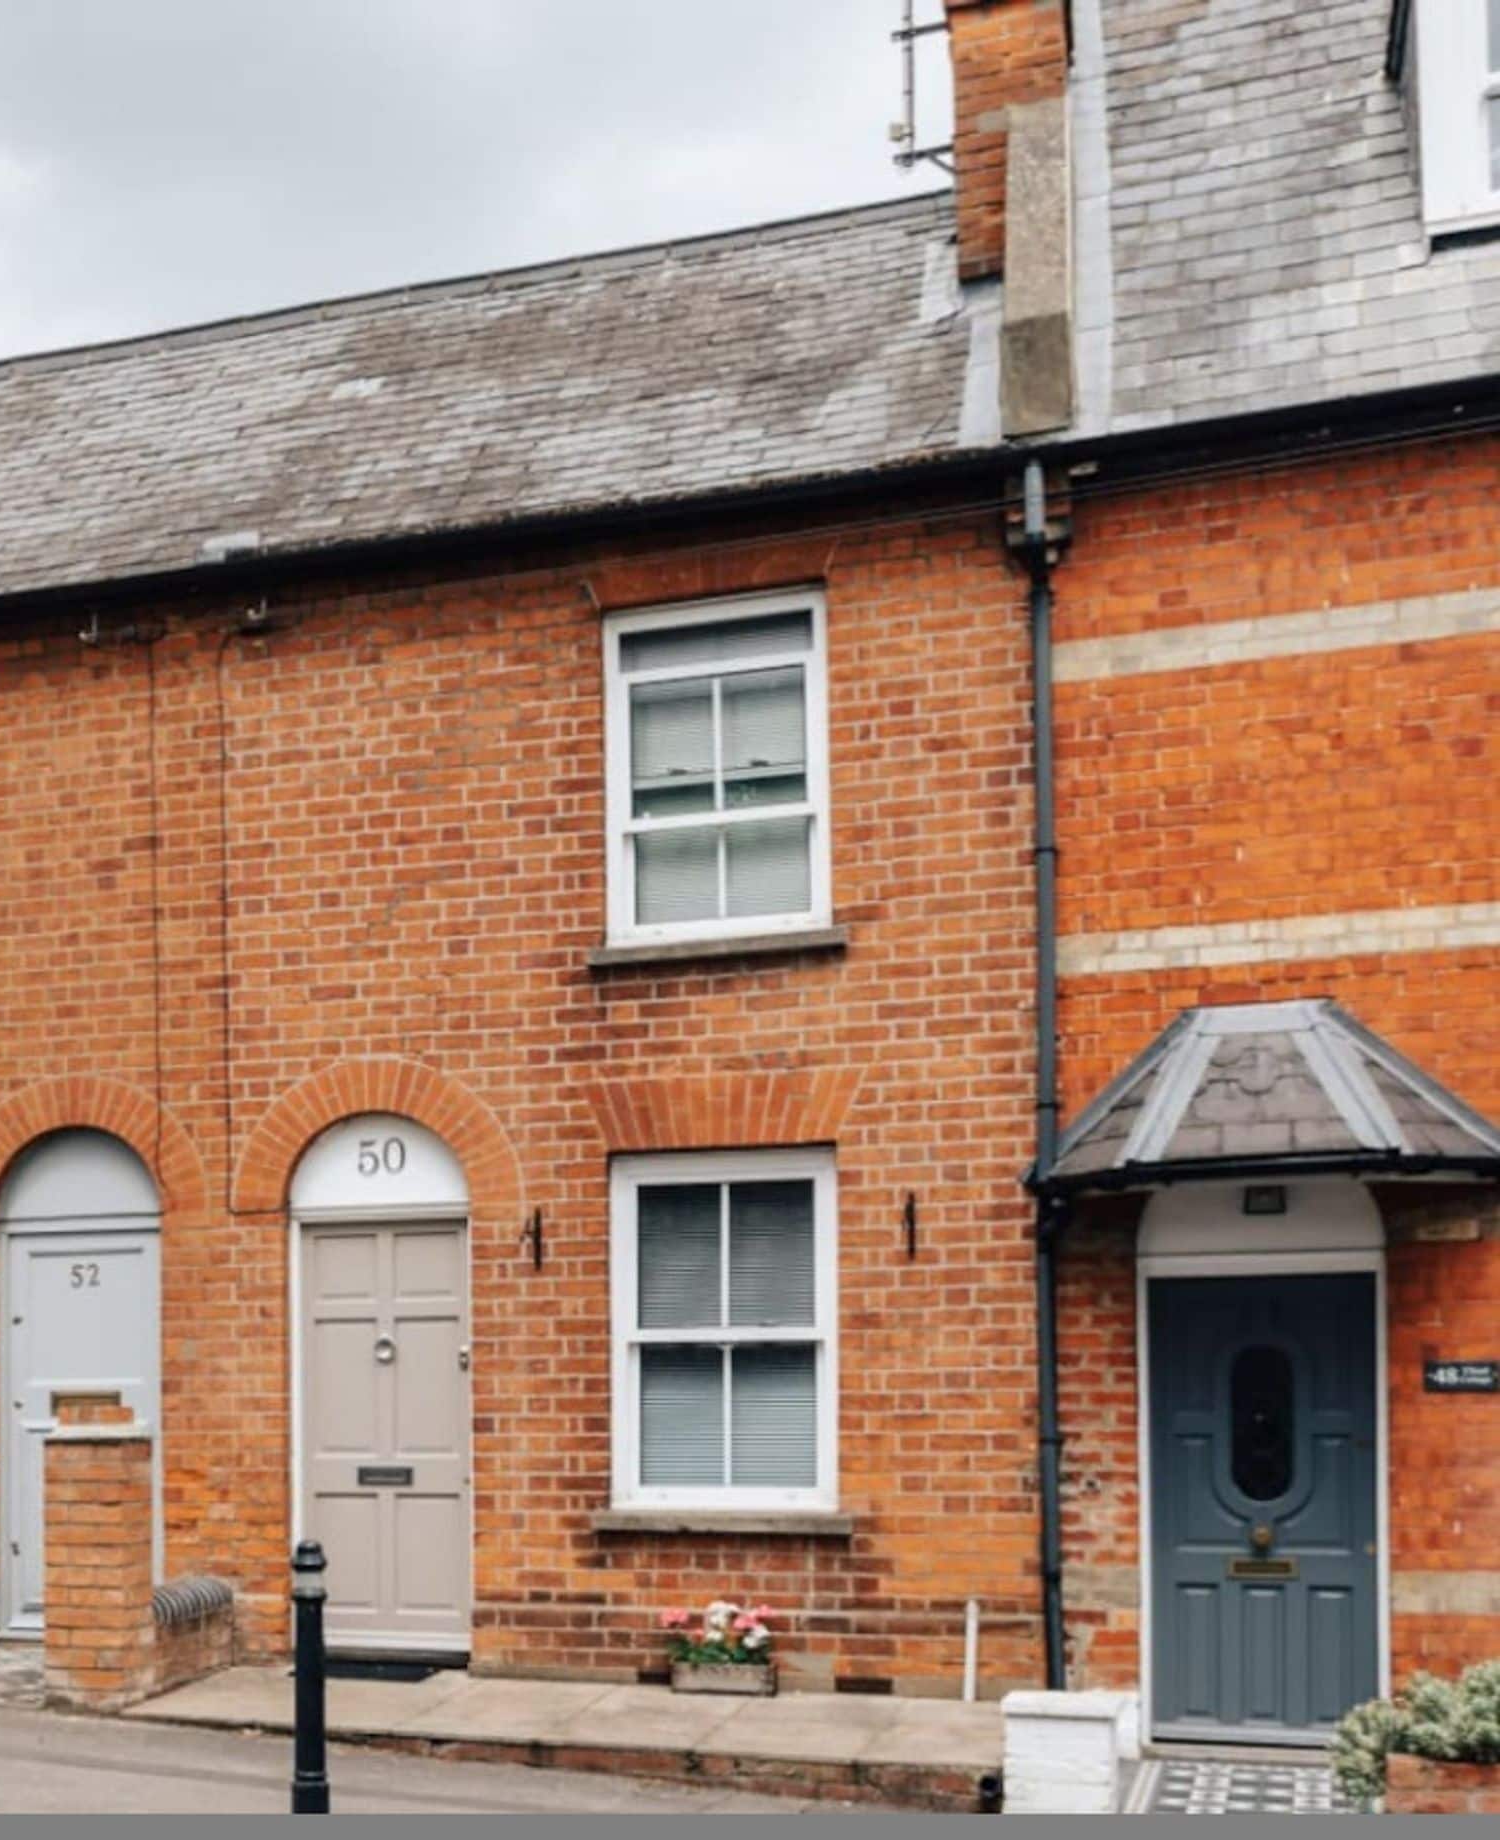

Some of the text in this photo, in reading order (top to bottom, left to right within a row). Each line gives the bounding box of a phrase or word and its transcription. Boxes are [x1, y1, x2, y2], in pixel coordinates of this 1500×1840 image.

[358, 1137, 406, 1176] 50
[70, 1263, 101, 1289] 52
[1434, 1366, 1459, 1385] 48
